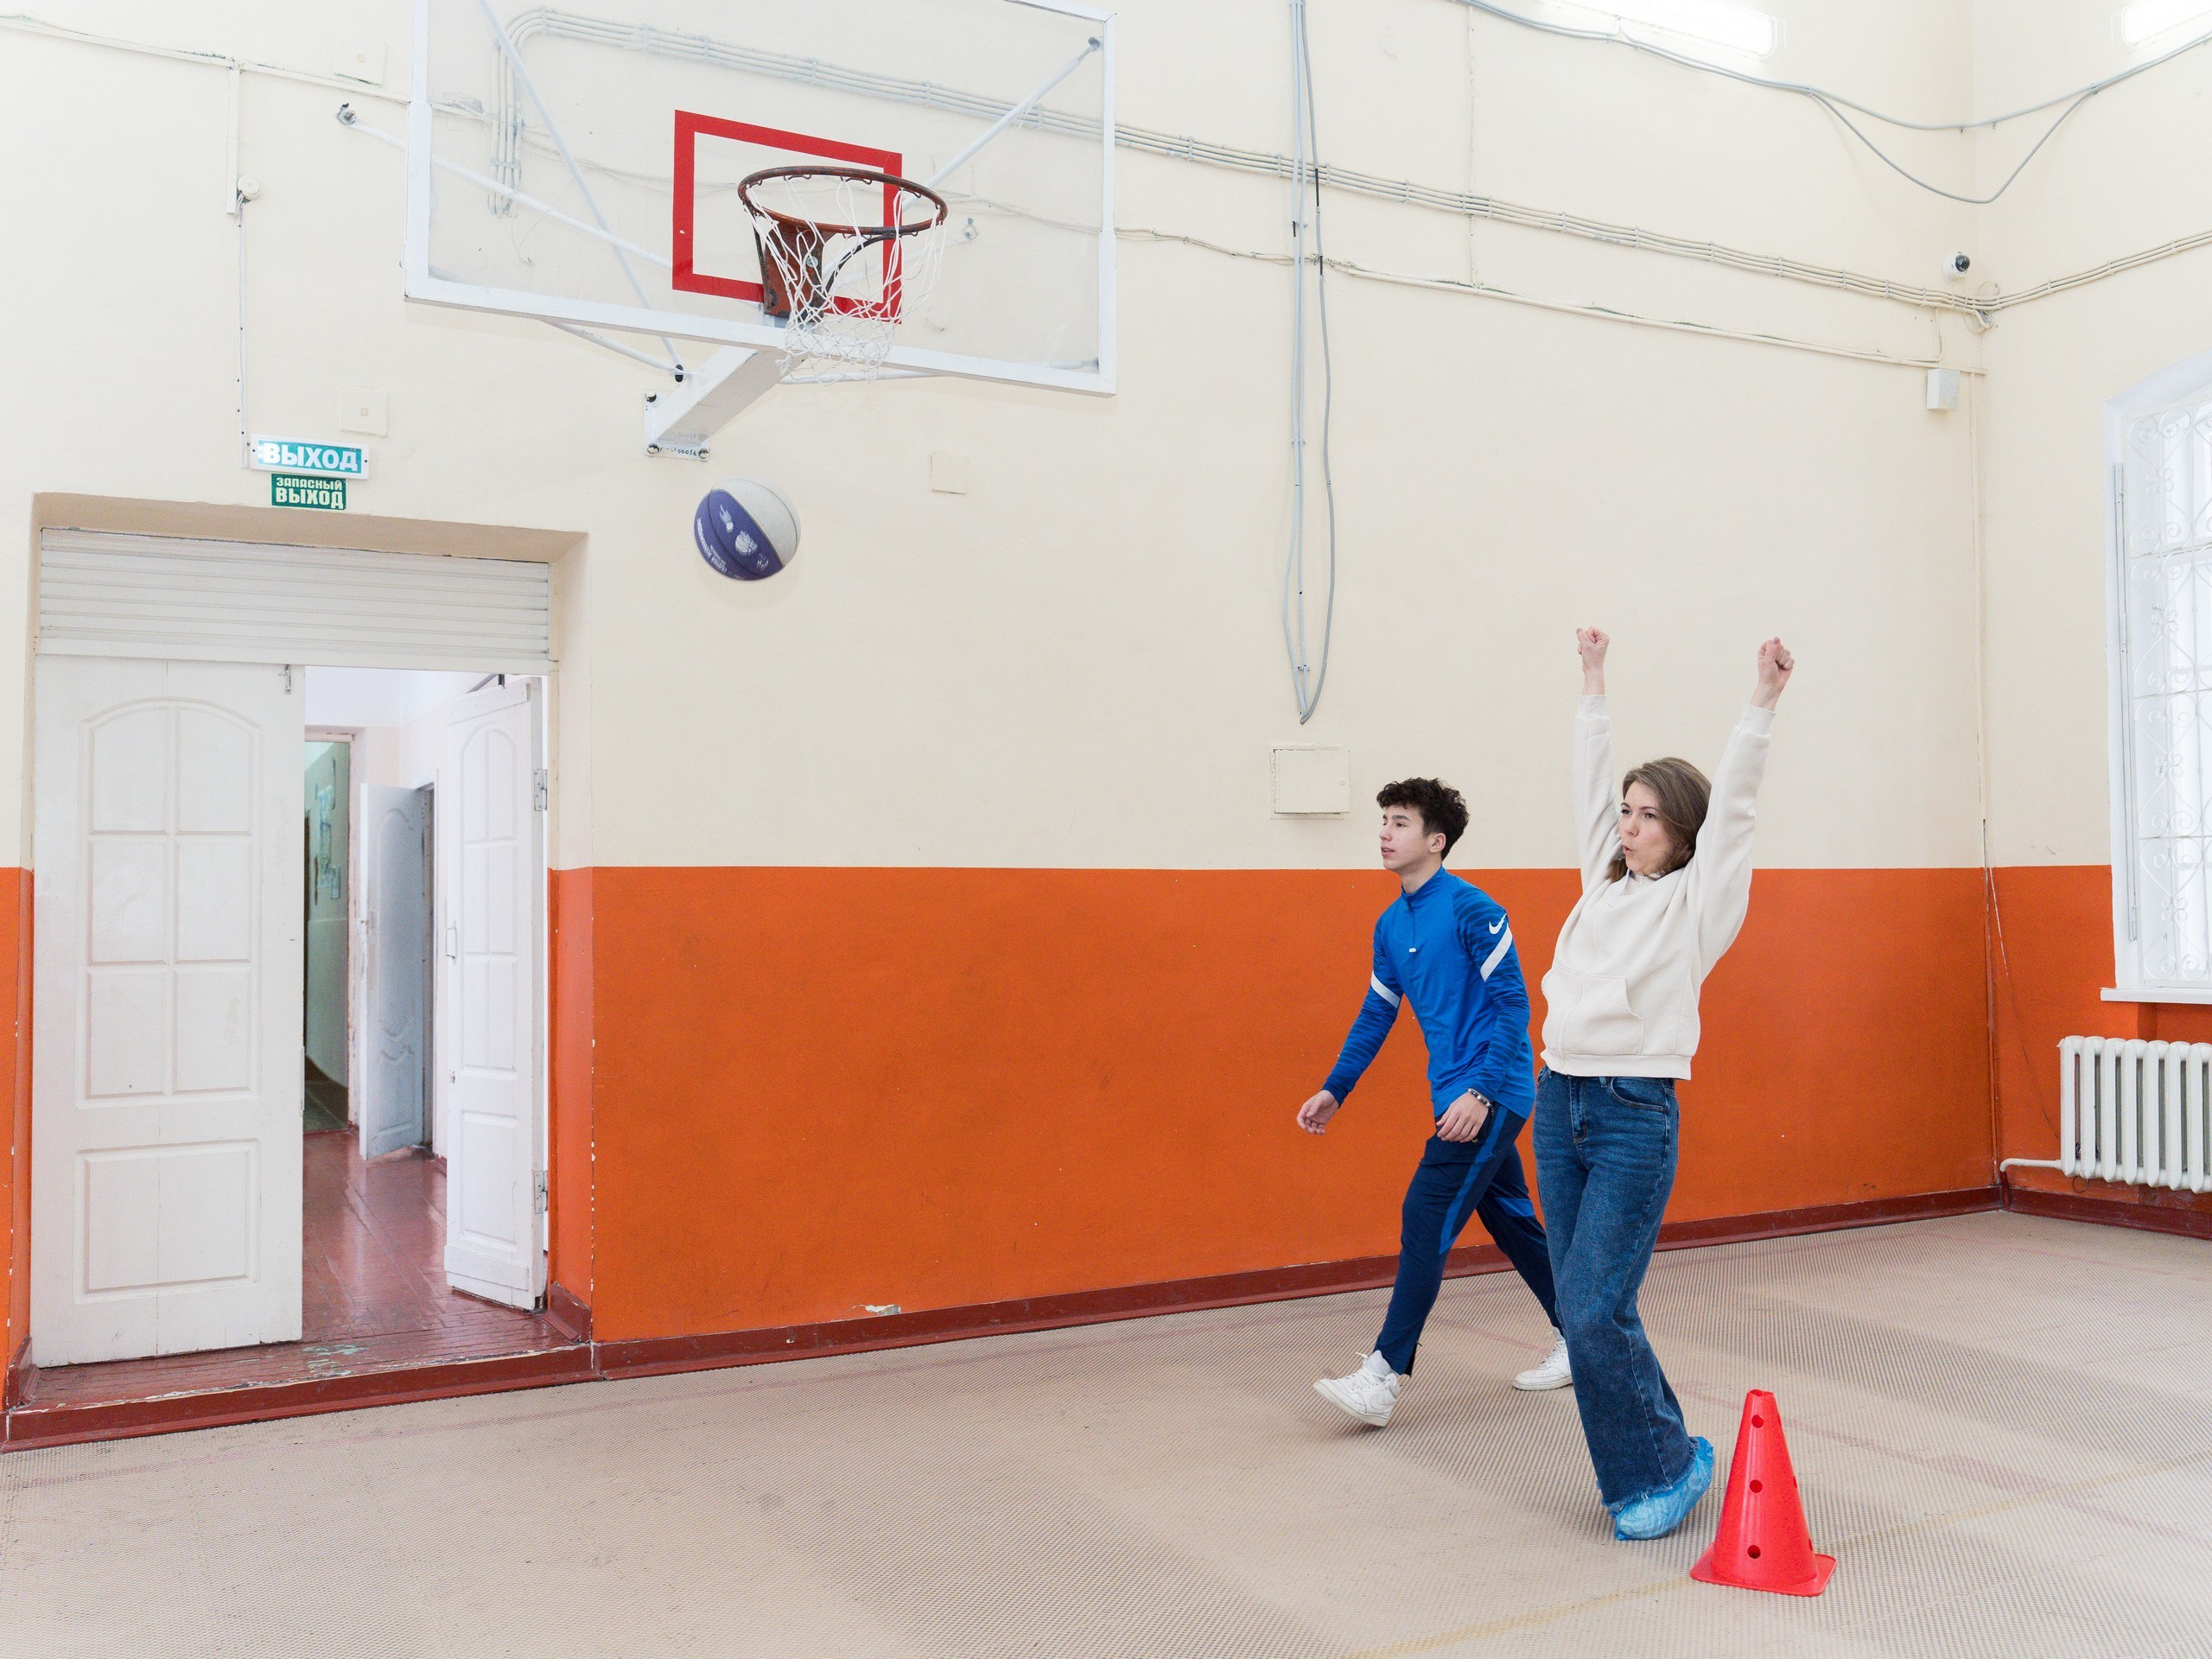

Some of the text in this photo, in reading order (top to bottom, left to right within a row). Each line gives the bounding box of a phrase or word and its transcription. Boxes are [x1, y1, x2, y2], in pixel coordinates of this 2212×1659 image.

[263, 442, 358, 472] ВЫХОД
[276, 477, 342, 490] ЗАПАСНЫЙ
[276, 487, 344, 509] ВЫХОД
